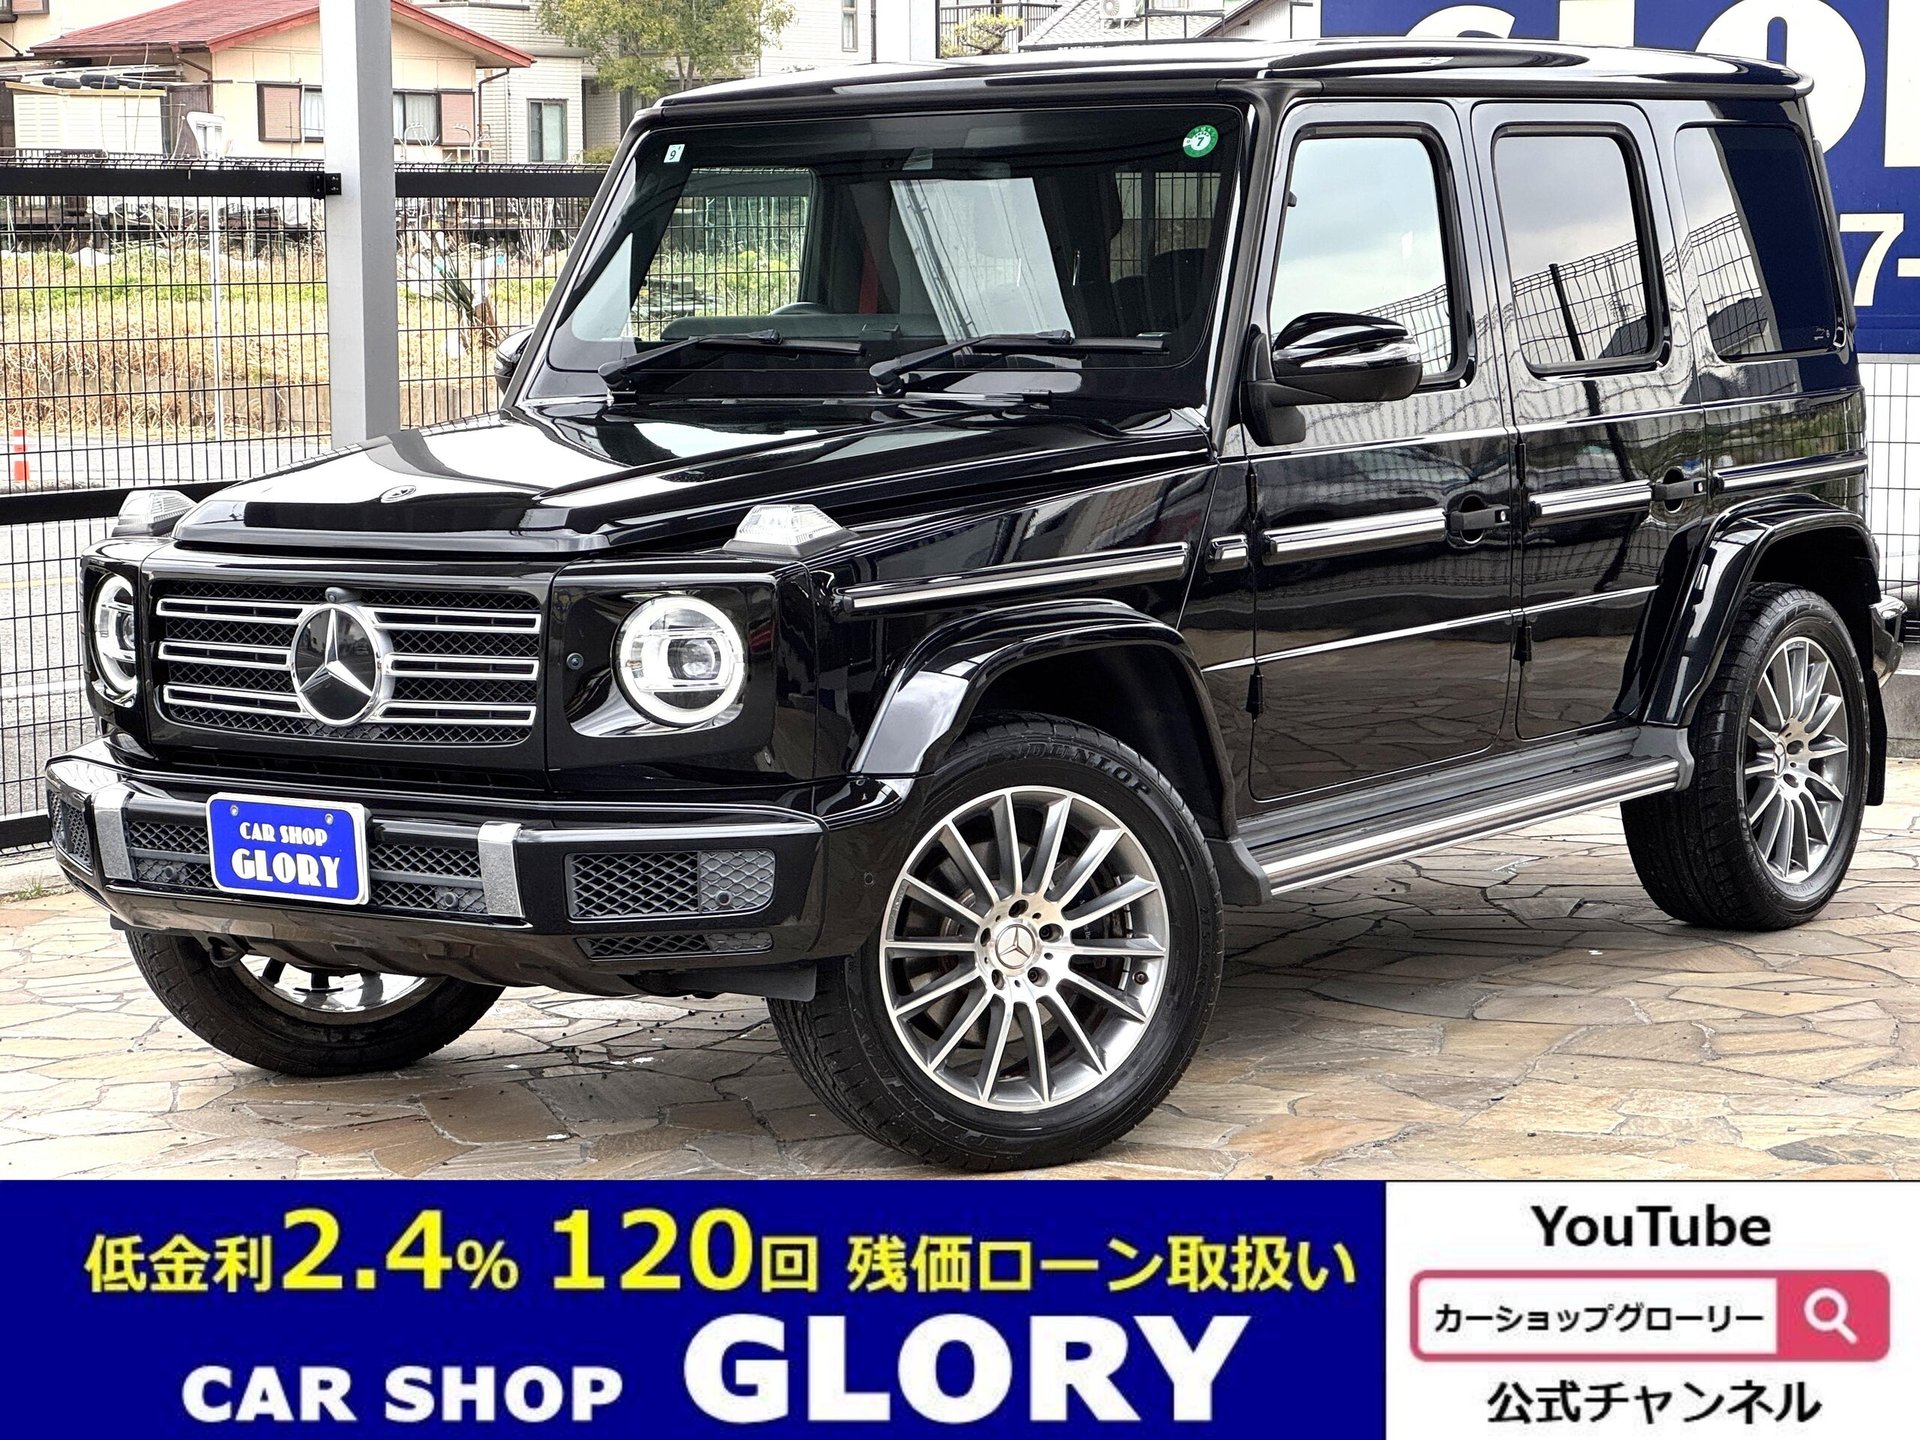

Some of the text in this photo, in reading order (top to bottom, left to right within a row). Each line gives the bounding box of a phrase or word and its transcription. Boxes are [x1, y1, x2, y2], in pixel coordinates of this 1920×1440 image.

[1024, 741, 1152, 797] DUNLOP
[239, 821, 328, 847] CAR SHOP
[231, 848, 341, 889] GLORY
